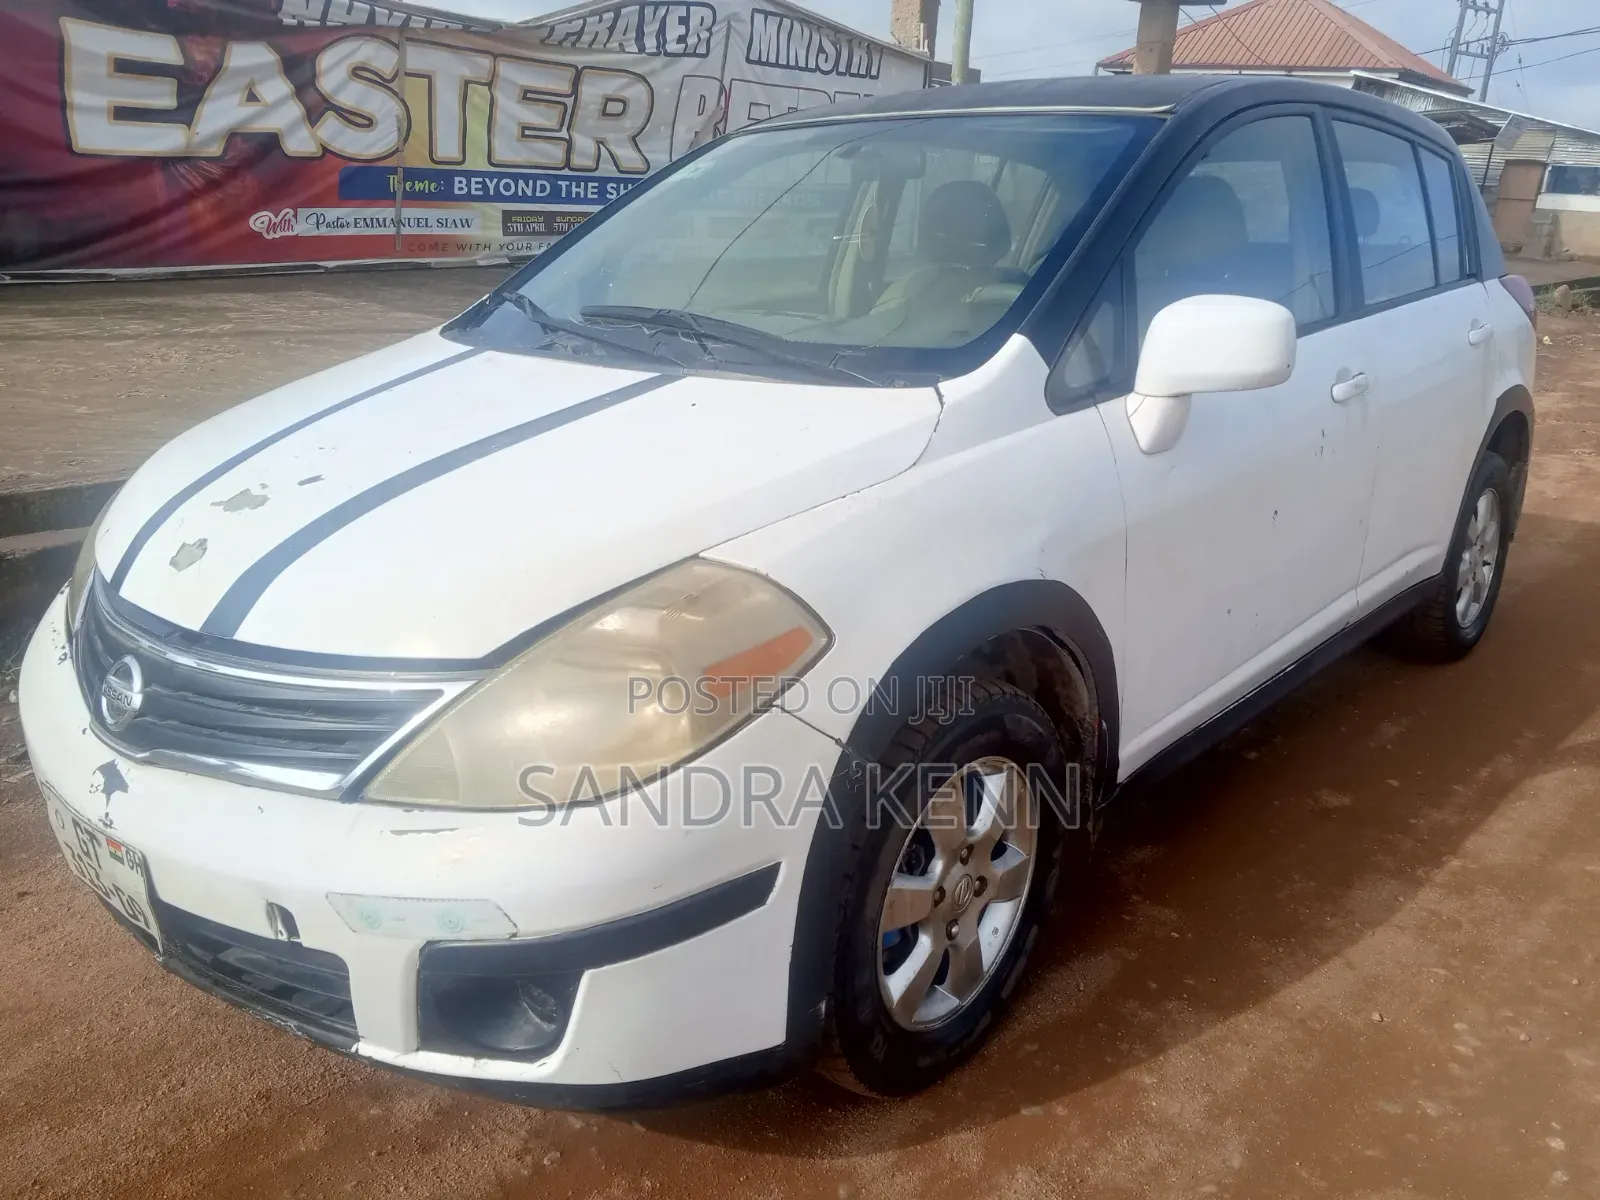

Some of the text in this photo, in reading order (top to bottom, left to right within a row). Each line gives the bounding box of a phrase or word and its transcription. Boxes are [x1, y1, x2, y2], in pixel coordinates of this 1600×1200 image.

[540, 2, 716, 58] PRAYER
[746, 8, 883, 79] MINISTRY
[60, 16, 653, 174] EASTER
[454, 177, 550, 197] BEYOND
[558, 181, 598, 198] THE
[254, 211, 474, 234] With Pastor EMMANUEL SIAW
[525, 223, 548, 232] APRIL
[408, 243, 449, 252] COME
[456, 243, 491, 252] WITH
[498, 242, 533, 251] YOUR
